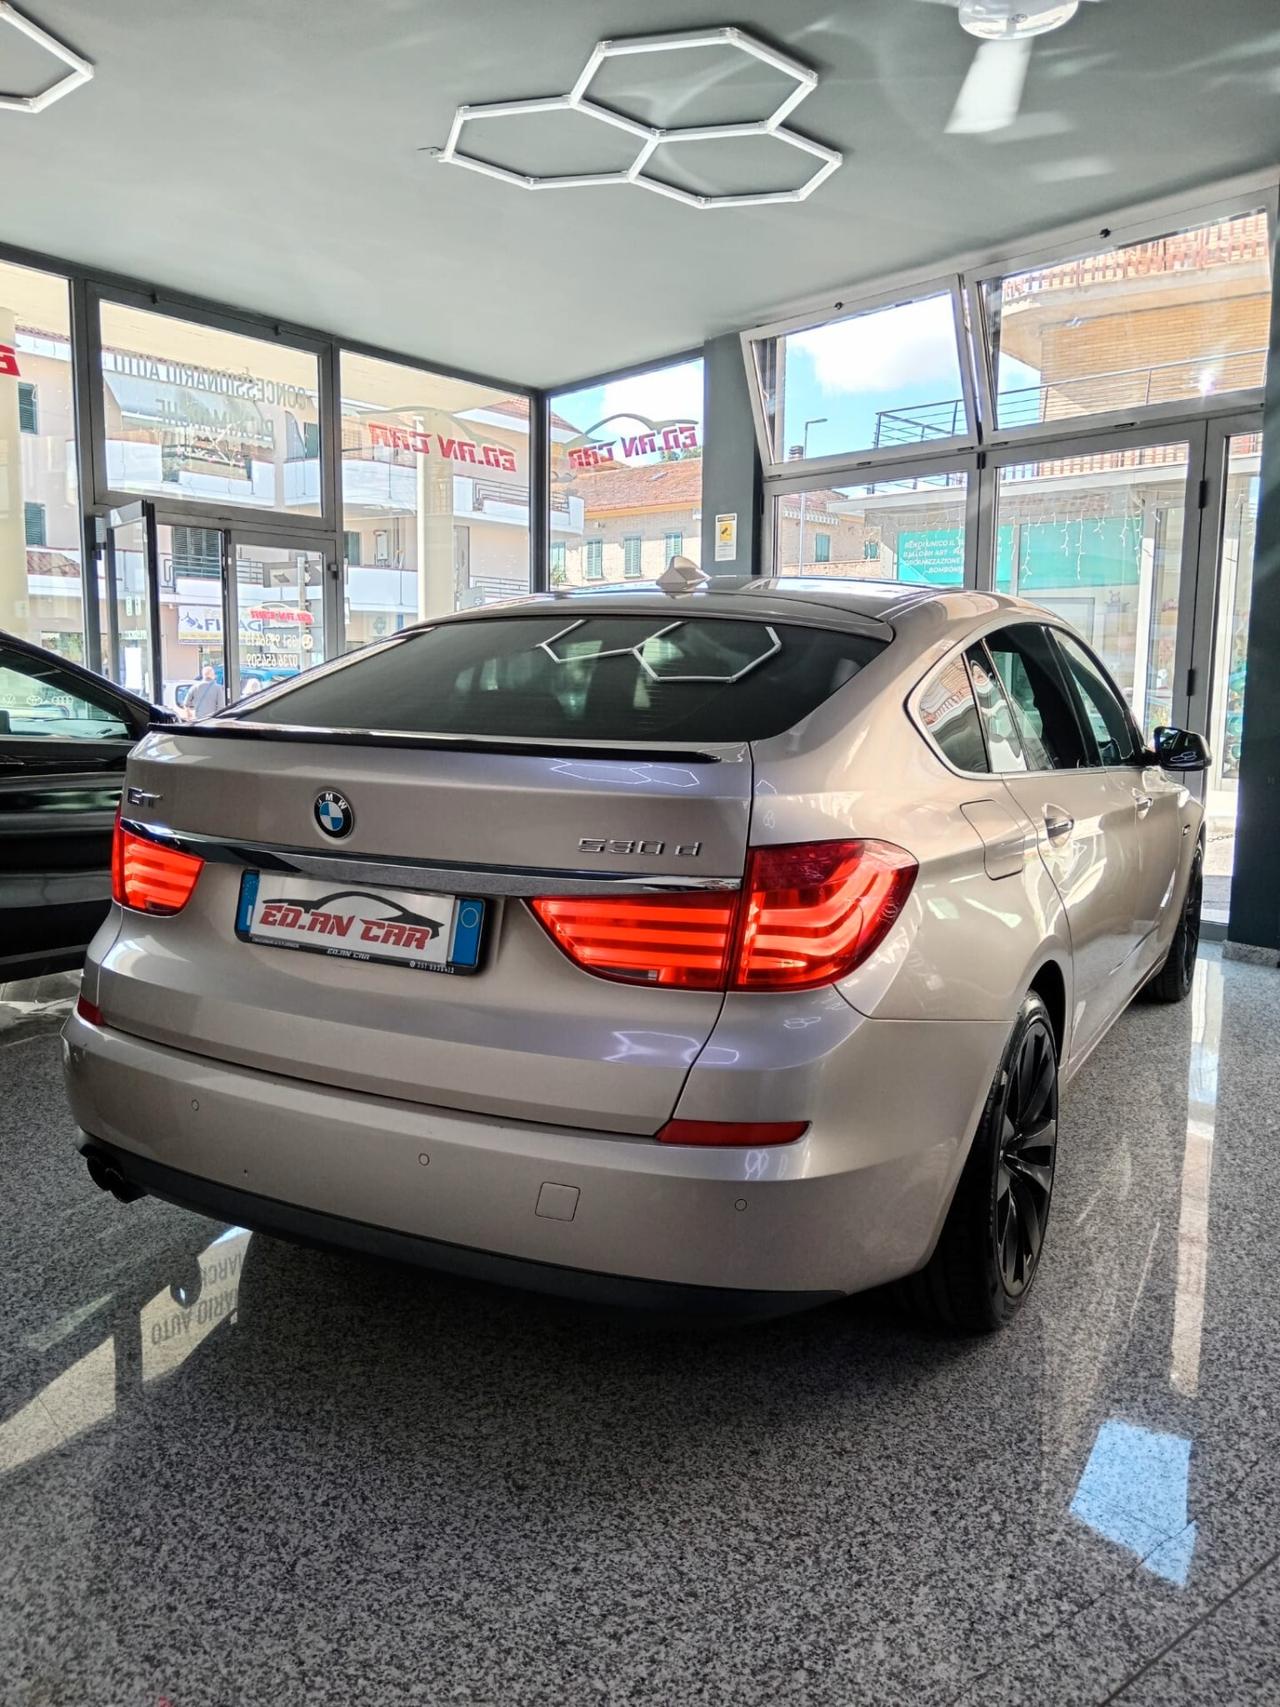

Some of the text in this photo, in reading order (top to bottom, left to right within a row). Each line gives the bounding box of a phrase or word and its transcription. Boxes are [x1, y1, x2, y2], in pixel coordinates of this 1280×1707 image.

[578, 837, 702, 856] 530 d
[259, 903, 432, 950] ED.AN CAR
